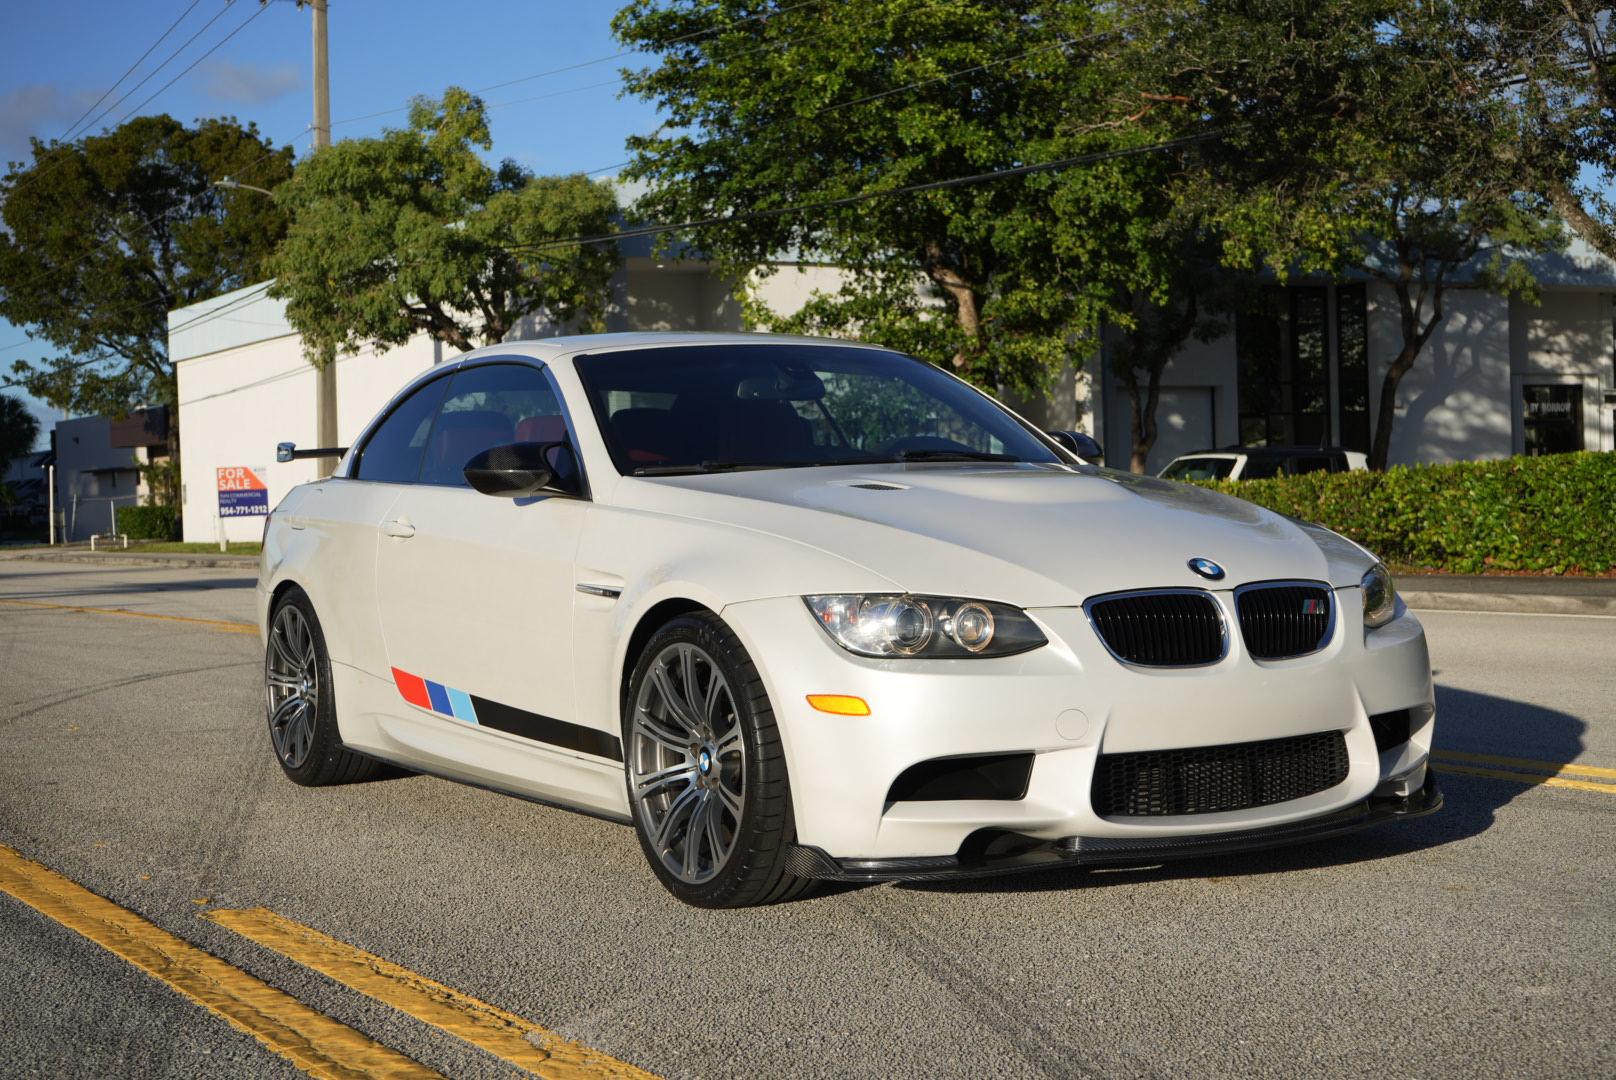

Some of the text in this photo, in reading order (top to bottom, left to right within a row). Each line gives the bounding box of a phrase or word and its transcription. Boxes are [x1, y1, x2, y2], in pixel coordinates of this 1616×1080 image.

[218, 468, 245, 479] FOR
[218, 479, 251, 490] SALE
[220, 505, 268, 515] 954-771-1212
